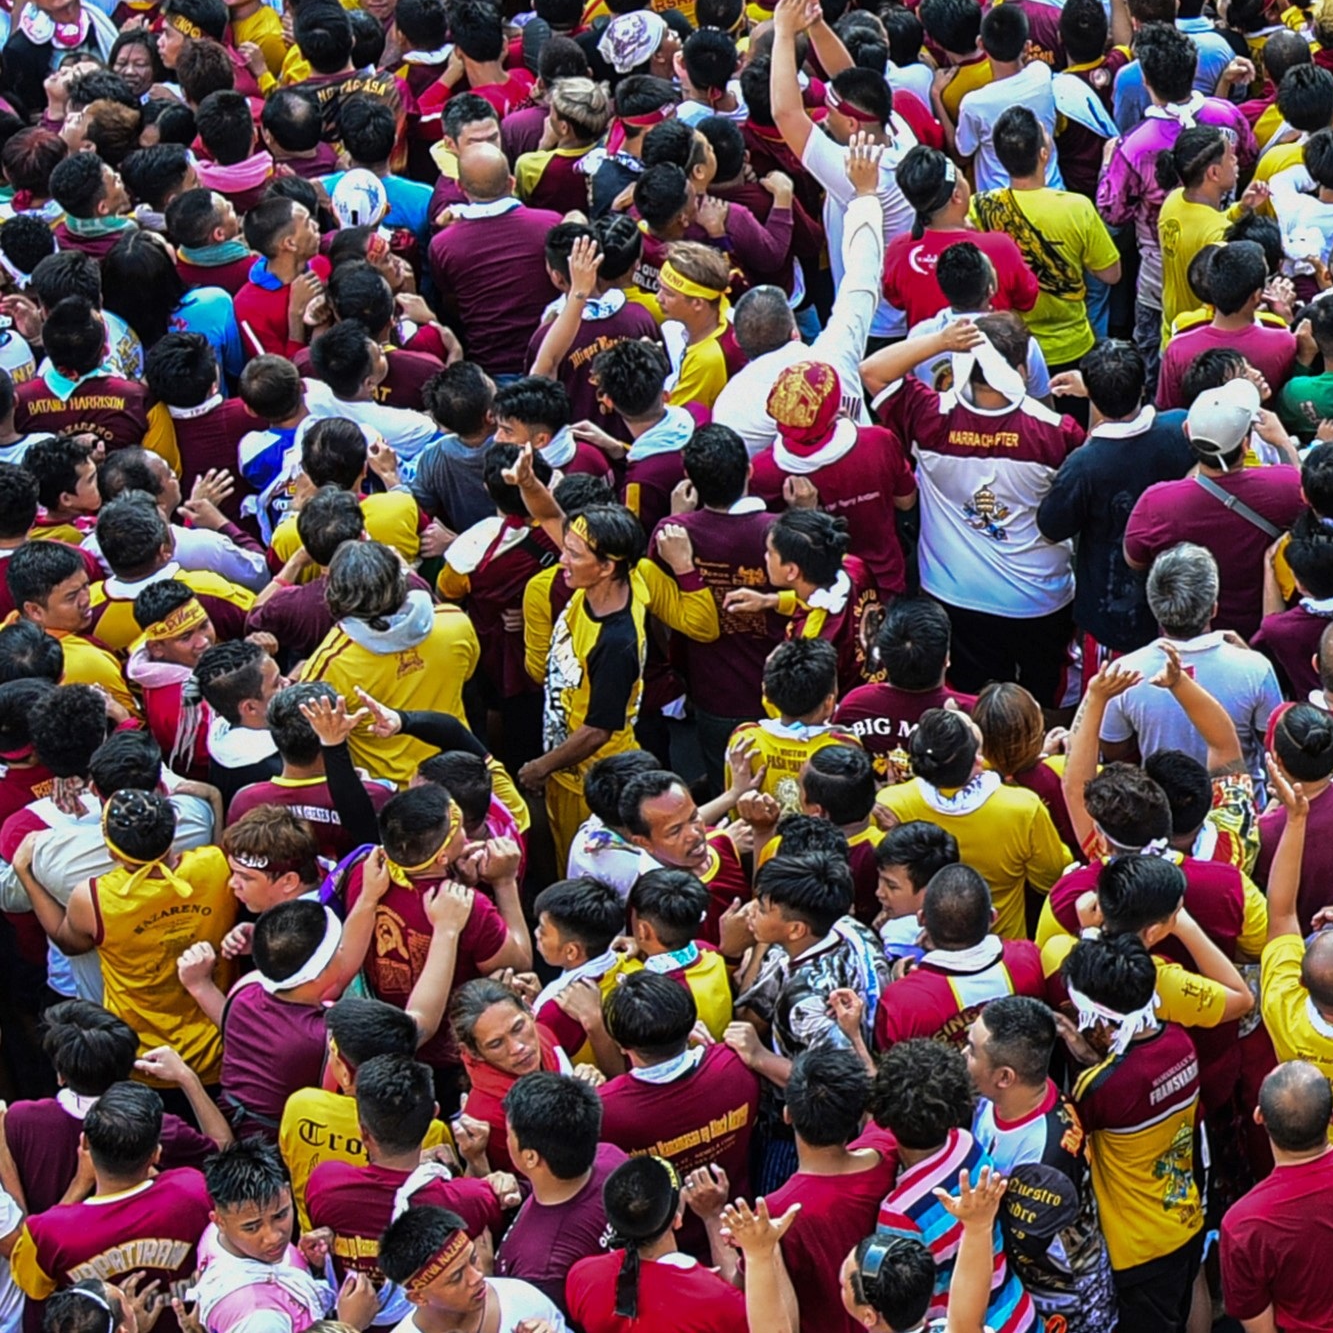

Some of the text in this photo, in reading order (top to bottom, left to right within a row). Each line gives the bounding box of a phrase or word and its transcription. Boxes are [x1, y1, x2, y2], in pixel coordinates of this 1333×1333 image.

[28, 394, 125, 416] BATANG HARRISON
[58, 420, 114, 442] AZARENO
[949, 429, 980, 445] NARRA
[851, 717, 892, 739] BIG
[296, 1117, 364, 1160] Tro
